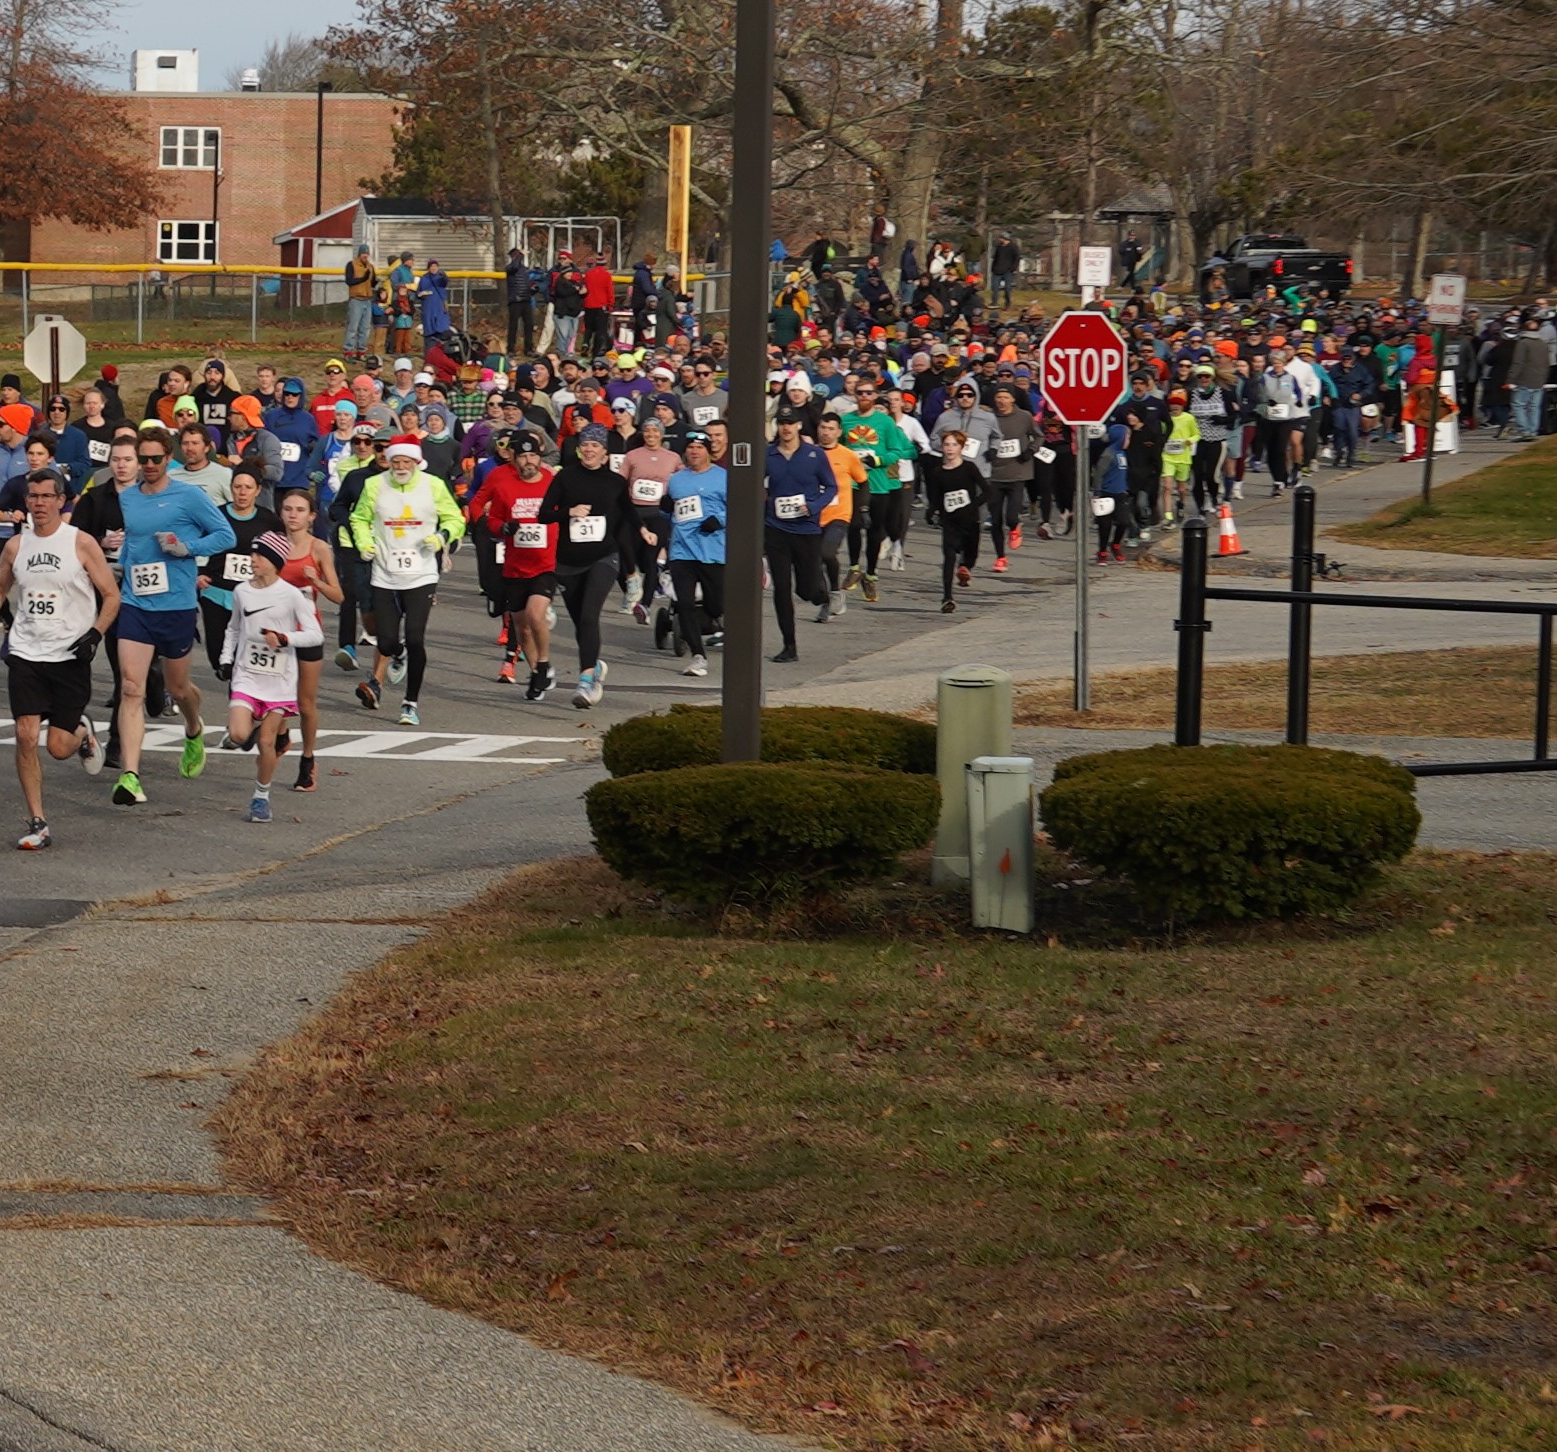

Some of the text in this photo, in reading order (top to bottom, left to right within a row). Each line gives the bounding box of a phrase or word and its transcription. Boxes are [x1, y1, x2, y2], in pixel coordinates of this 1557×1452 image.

[1046, 347, 1121, 389] STOP
[518, 530, 540, 543] 206
[580, 524, 595, 536] 31
[25, 551, 62, 571] MAINE
[397, 557, 412, 569] 19
[135, 573, 160, 589] 352
[27, 600, 55, 615] 295
[249, 652, 277, 669] 351
